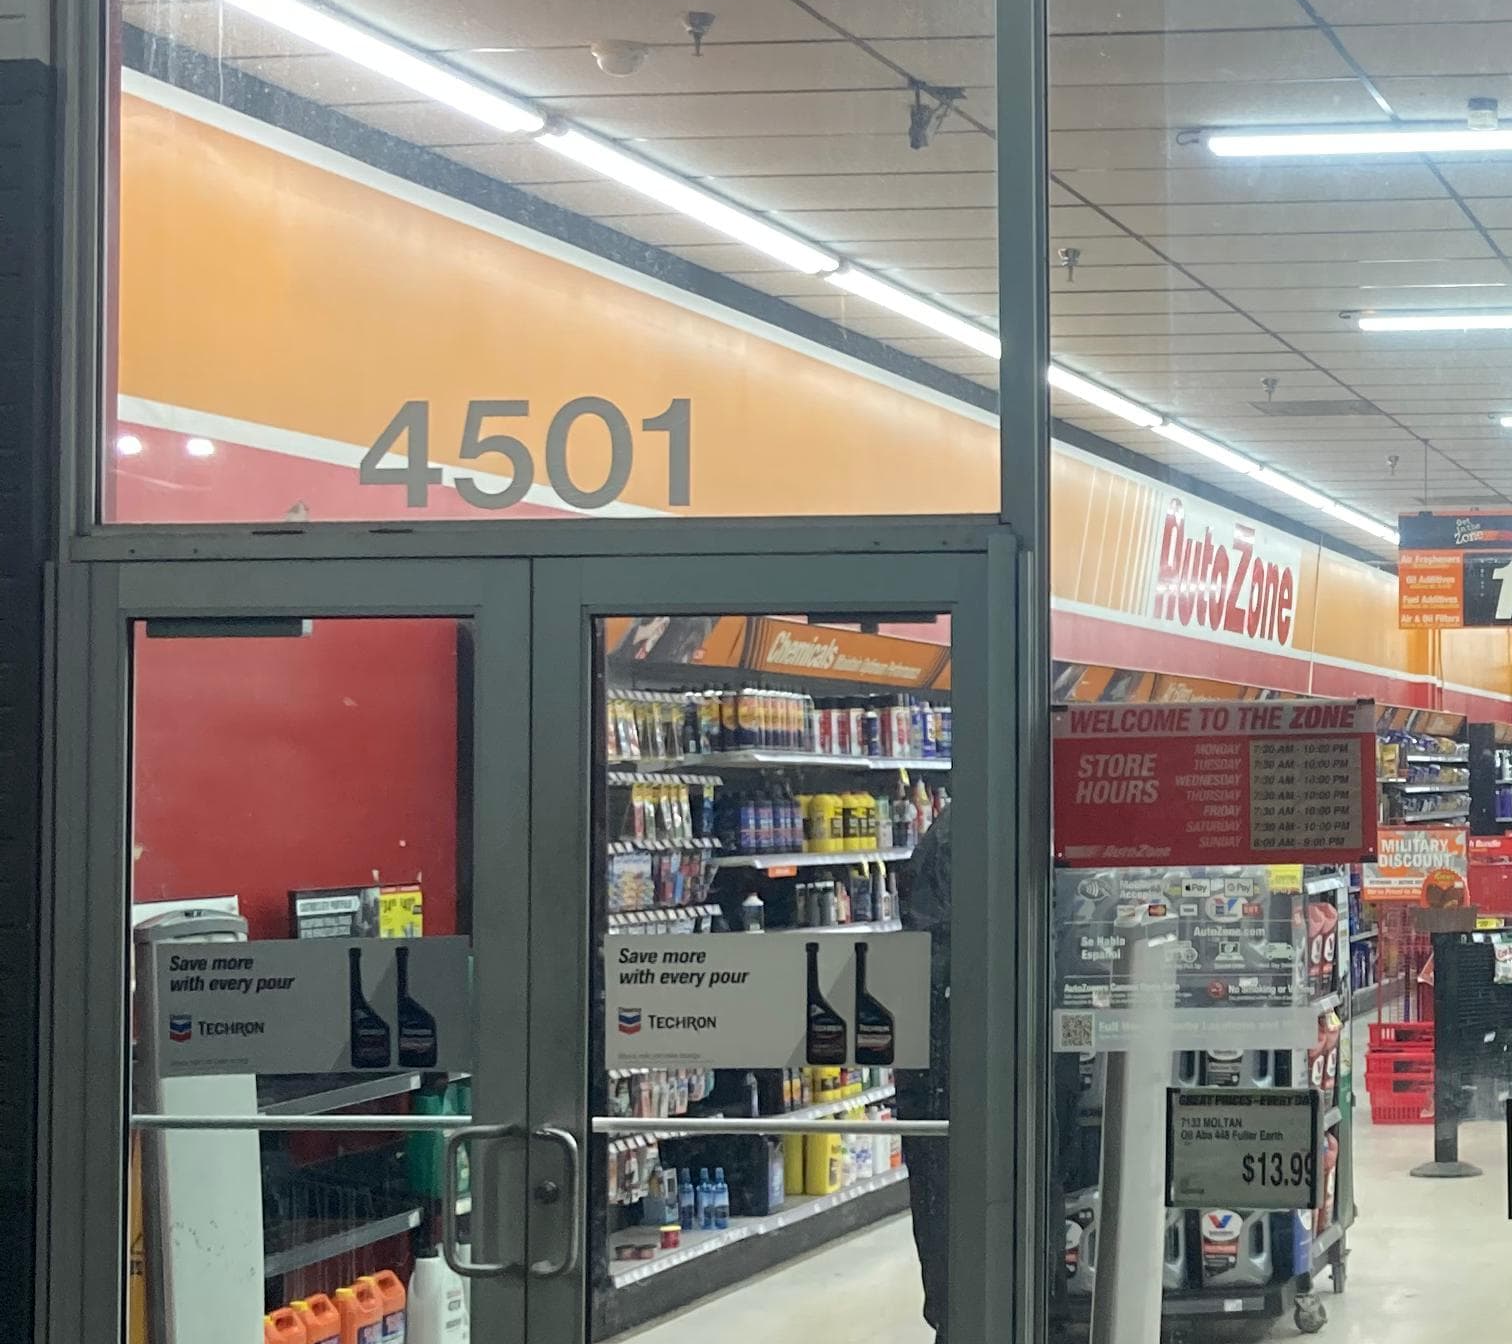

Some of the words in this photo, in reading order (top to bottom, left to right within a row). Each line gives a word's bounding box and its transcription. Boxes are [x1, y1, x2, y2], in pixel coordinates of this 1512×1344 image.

[358, 396, 692, 509] 4501
[1154, 498, 1293, 646] AutoZone
[767, 630, 839, 669] Chemicals
[1070, 708, 1192, 733] WELCOME
[1199, 708, 1229, 731] TO
[1238, 707, 1284, 731] THE
[1289, 706, 1356, 729] ZONE
[1078, 754, 1158, 778] STORE
[1075, 780, 1160, 804] HOURS
[1381, 838, 1449, 854] MILITARY
[1378, 854, 1451, 869] DISCOUNT
[1194, 926, 1265, 937] AutoZone.com
[169, 956, 207, 972] Save
[212, 957, 254, 971] more
[619, 948, 658, 964] Save
[662, 950, 706, 964] more
[170, 975, 204, 993] with
[209, 977, 251, 995] every
[256, 976, 296, 993] pour
[619, 969, 655, 985] with
[660, 971, 705, 987] every
[708, 971, 750, 987] pour
[1228, 985, 1239, 993] No
[1288, 984, 1315, 995] Ving
[198, 1021, 265, 1037] TECHRON
[648, 1015, 717, 1031] TECHRON
[1203, 1118, 1242, 1128] MOLTAN
[1232, 1130, 1257, 1140] Fuller
[1260, 1130, 1283, 1140] Earth
[1242, 1152, 1312, 1187] $13.99
